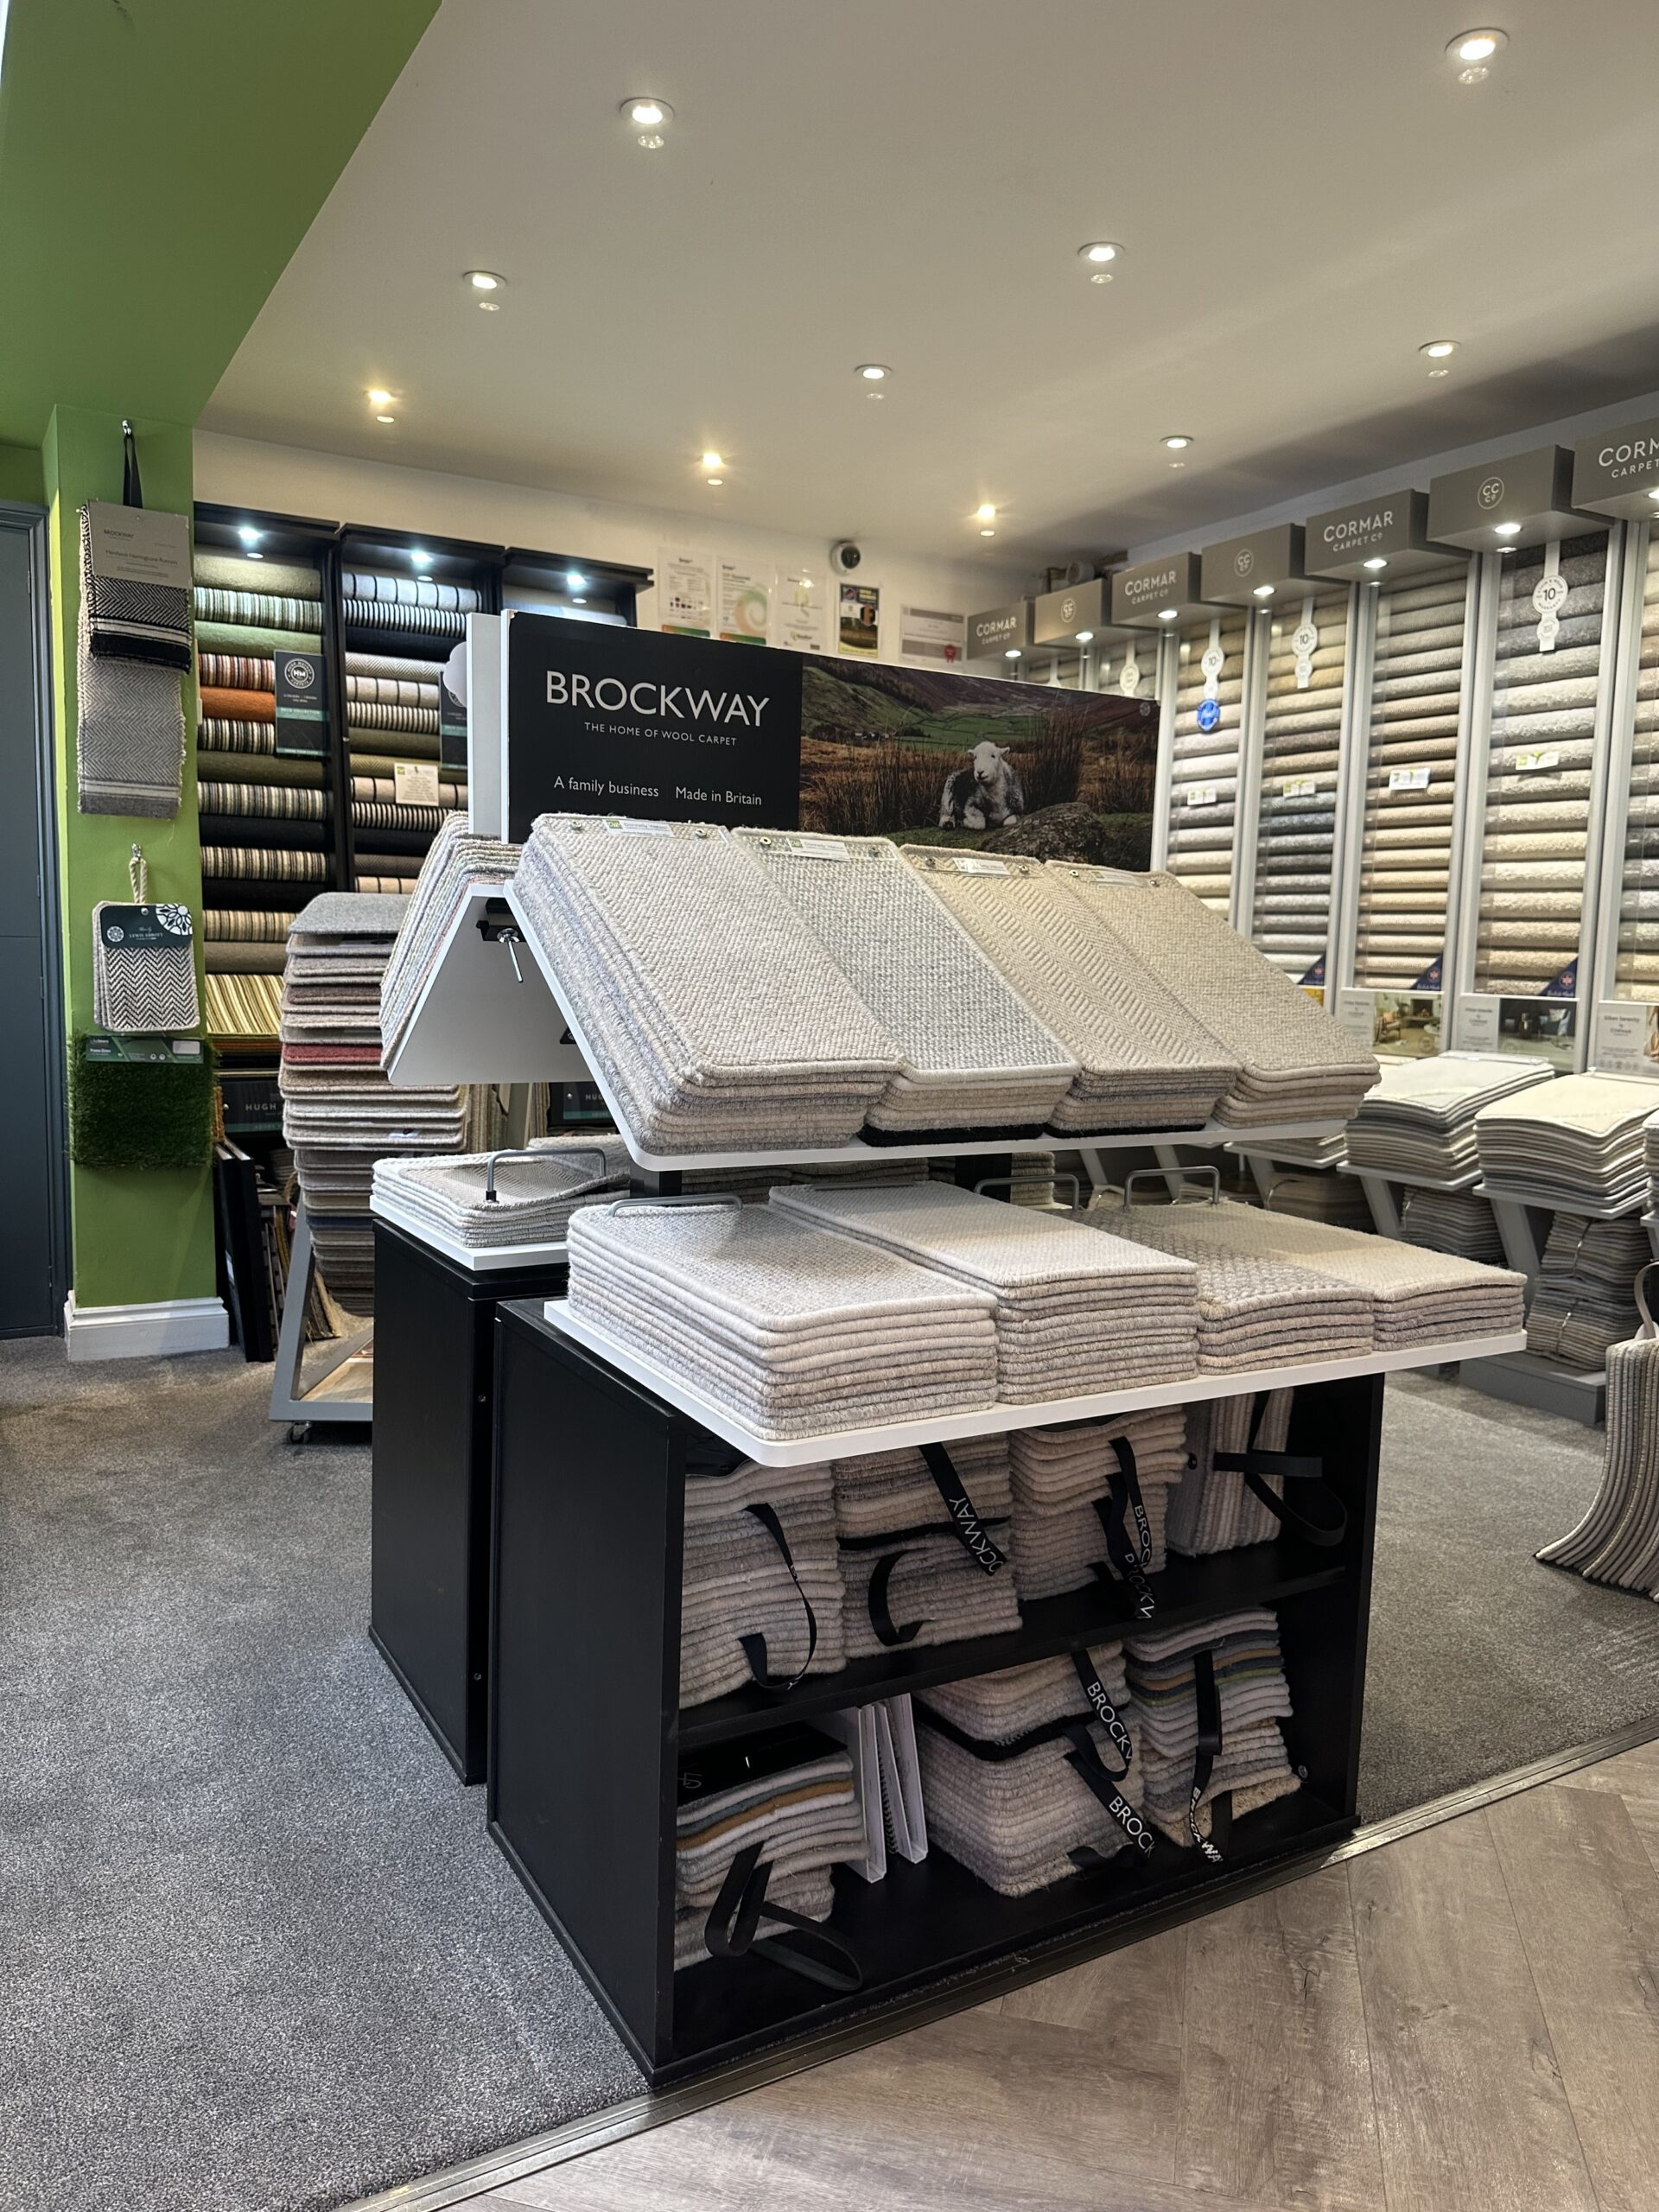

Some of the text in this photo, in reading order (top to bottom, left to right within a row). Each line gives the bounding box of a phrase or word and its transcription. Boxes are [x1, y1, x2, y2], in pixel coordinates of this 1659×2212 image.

[1611, 458, 1659, 478] CARPET
[1323, 511, 1393, 543] CORMAR
[1332, 536, 1368, 552] CARPET
[1125, 570, 1176, 596] CORMAR
[1131, 591, 1158, 605] CARPET
[1542, 588, 1556, 601] 10
[976, 616, 1017, 637] CORMAR
[1300, 633, 1309, 645] 10
[293, 669, 306, 678] HM
[545, 670, 771, 728] BROCKWAY
[584, 721, 737, 747] THE HOME OF WOOL CARPET
[554, 776, 659, 798] A family business
[676, 786, 762, 806] Made in Britain
[245, 1103, 276, 1111] HUGH
